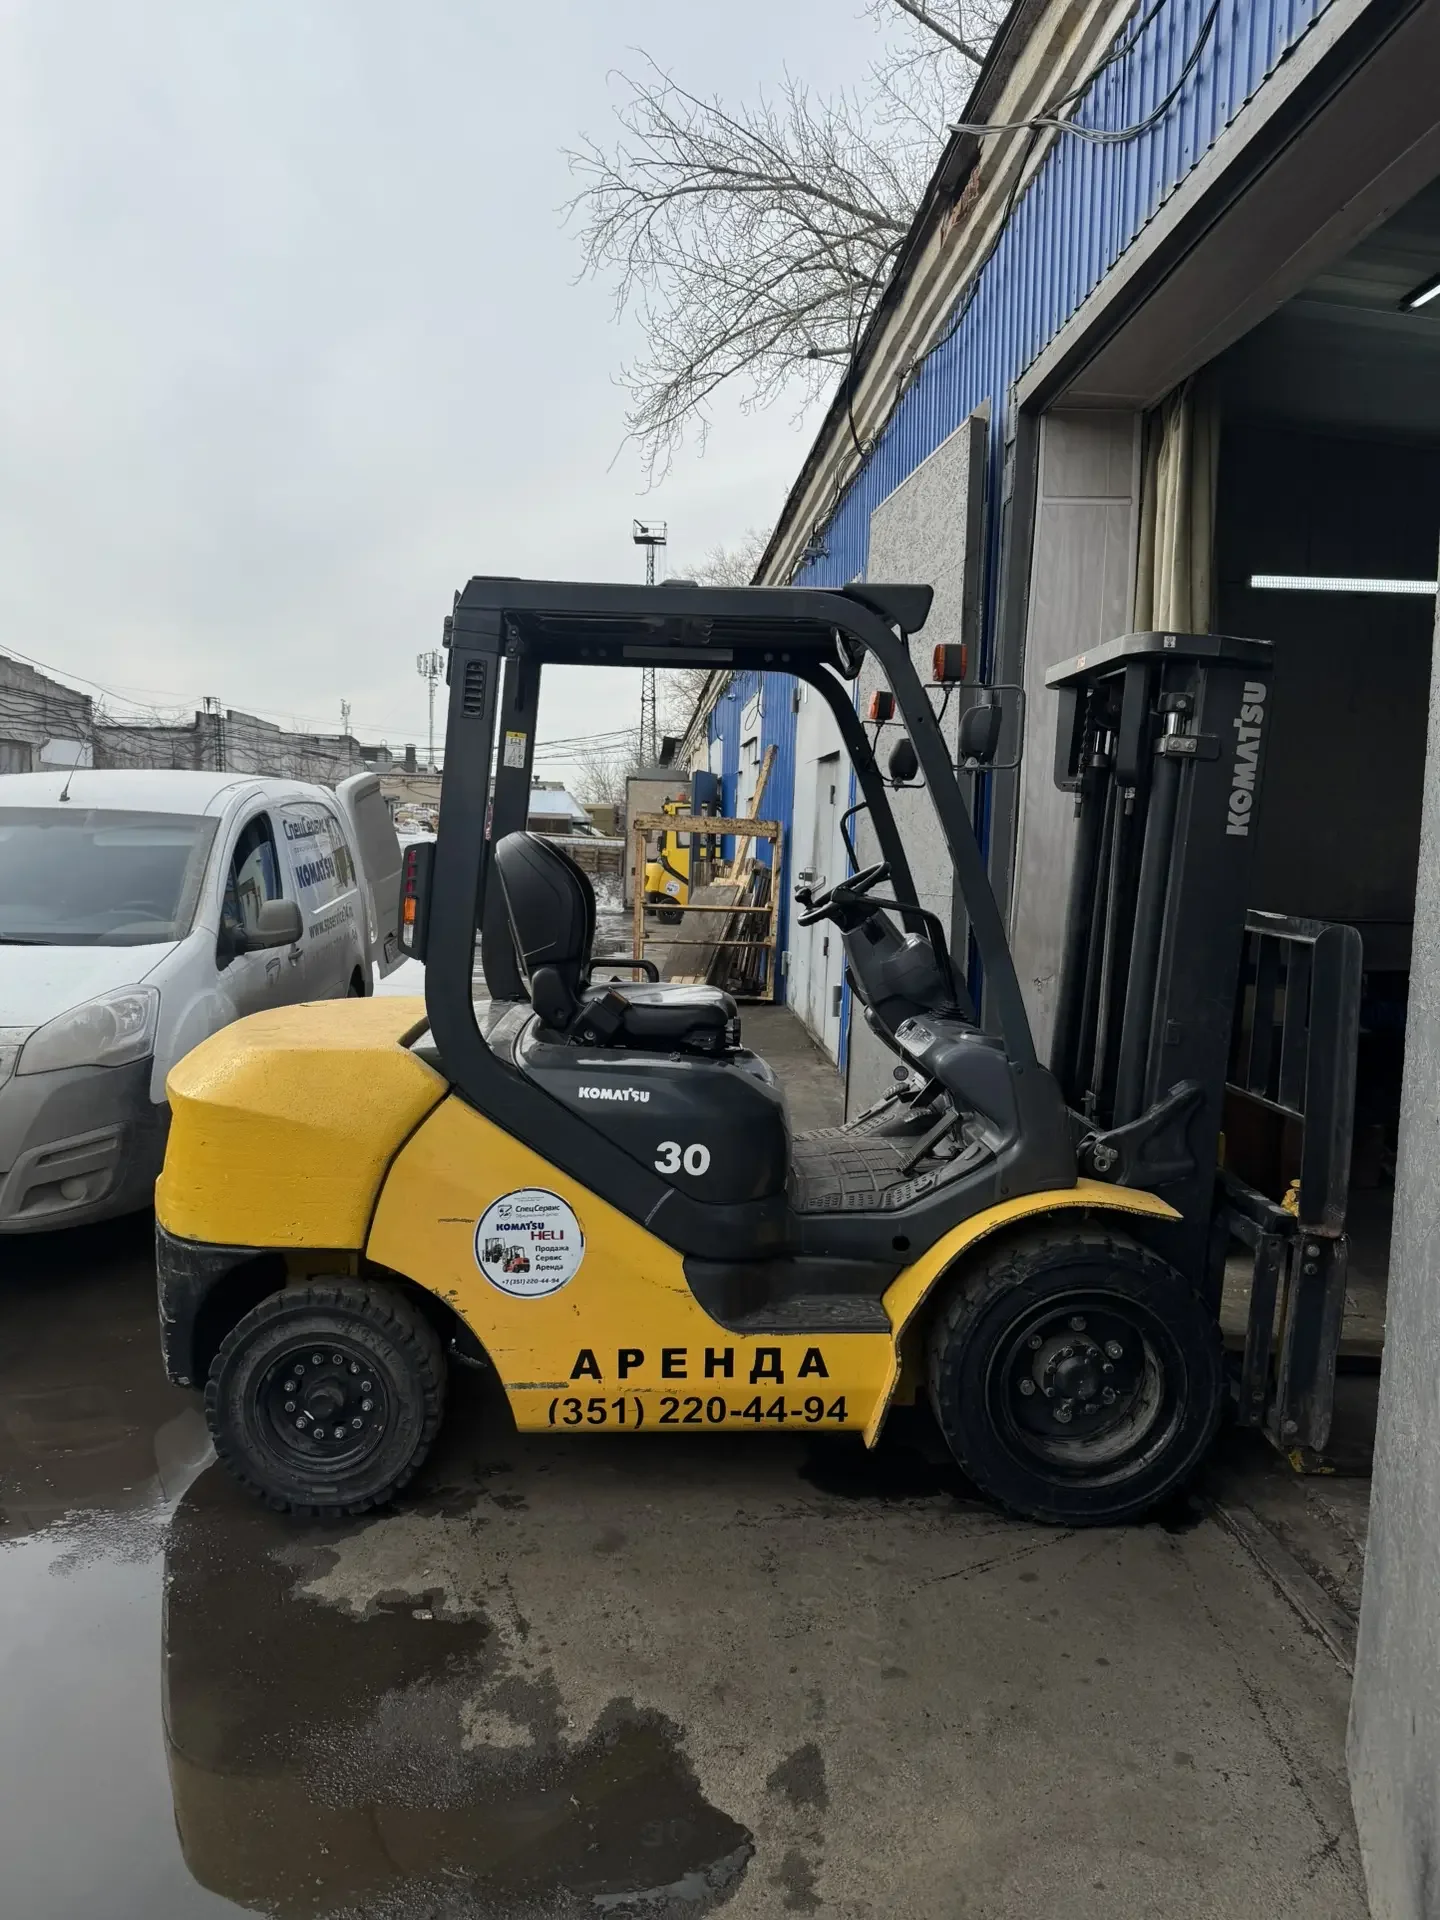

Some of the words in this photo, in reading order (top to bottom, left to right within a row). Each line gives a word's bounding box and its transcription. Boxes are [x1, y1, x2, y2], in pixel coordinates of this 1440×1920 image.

[1226, 681, 1267, 836] KOMATSU
[295, 855, 336, 889] KOMATSU
[578, 1086, 650, 1103] KOMATSU
[654, 1140, 711, 1176] 30
[515, 1204, 560, 1213] СпецСервис
[496, 1220, 545, 1231] KOMATSU
[530, 1230, 564, 1240] HELI
[535, 1263, 564, 1271] Аренда
[570, 1347, 830, 1384] АРЕНДА
[548, 1396, 645, 1429] (351)
[658, 1395, 849, 1424] 220-44-94
